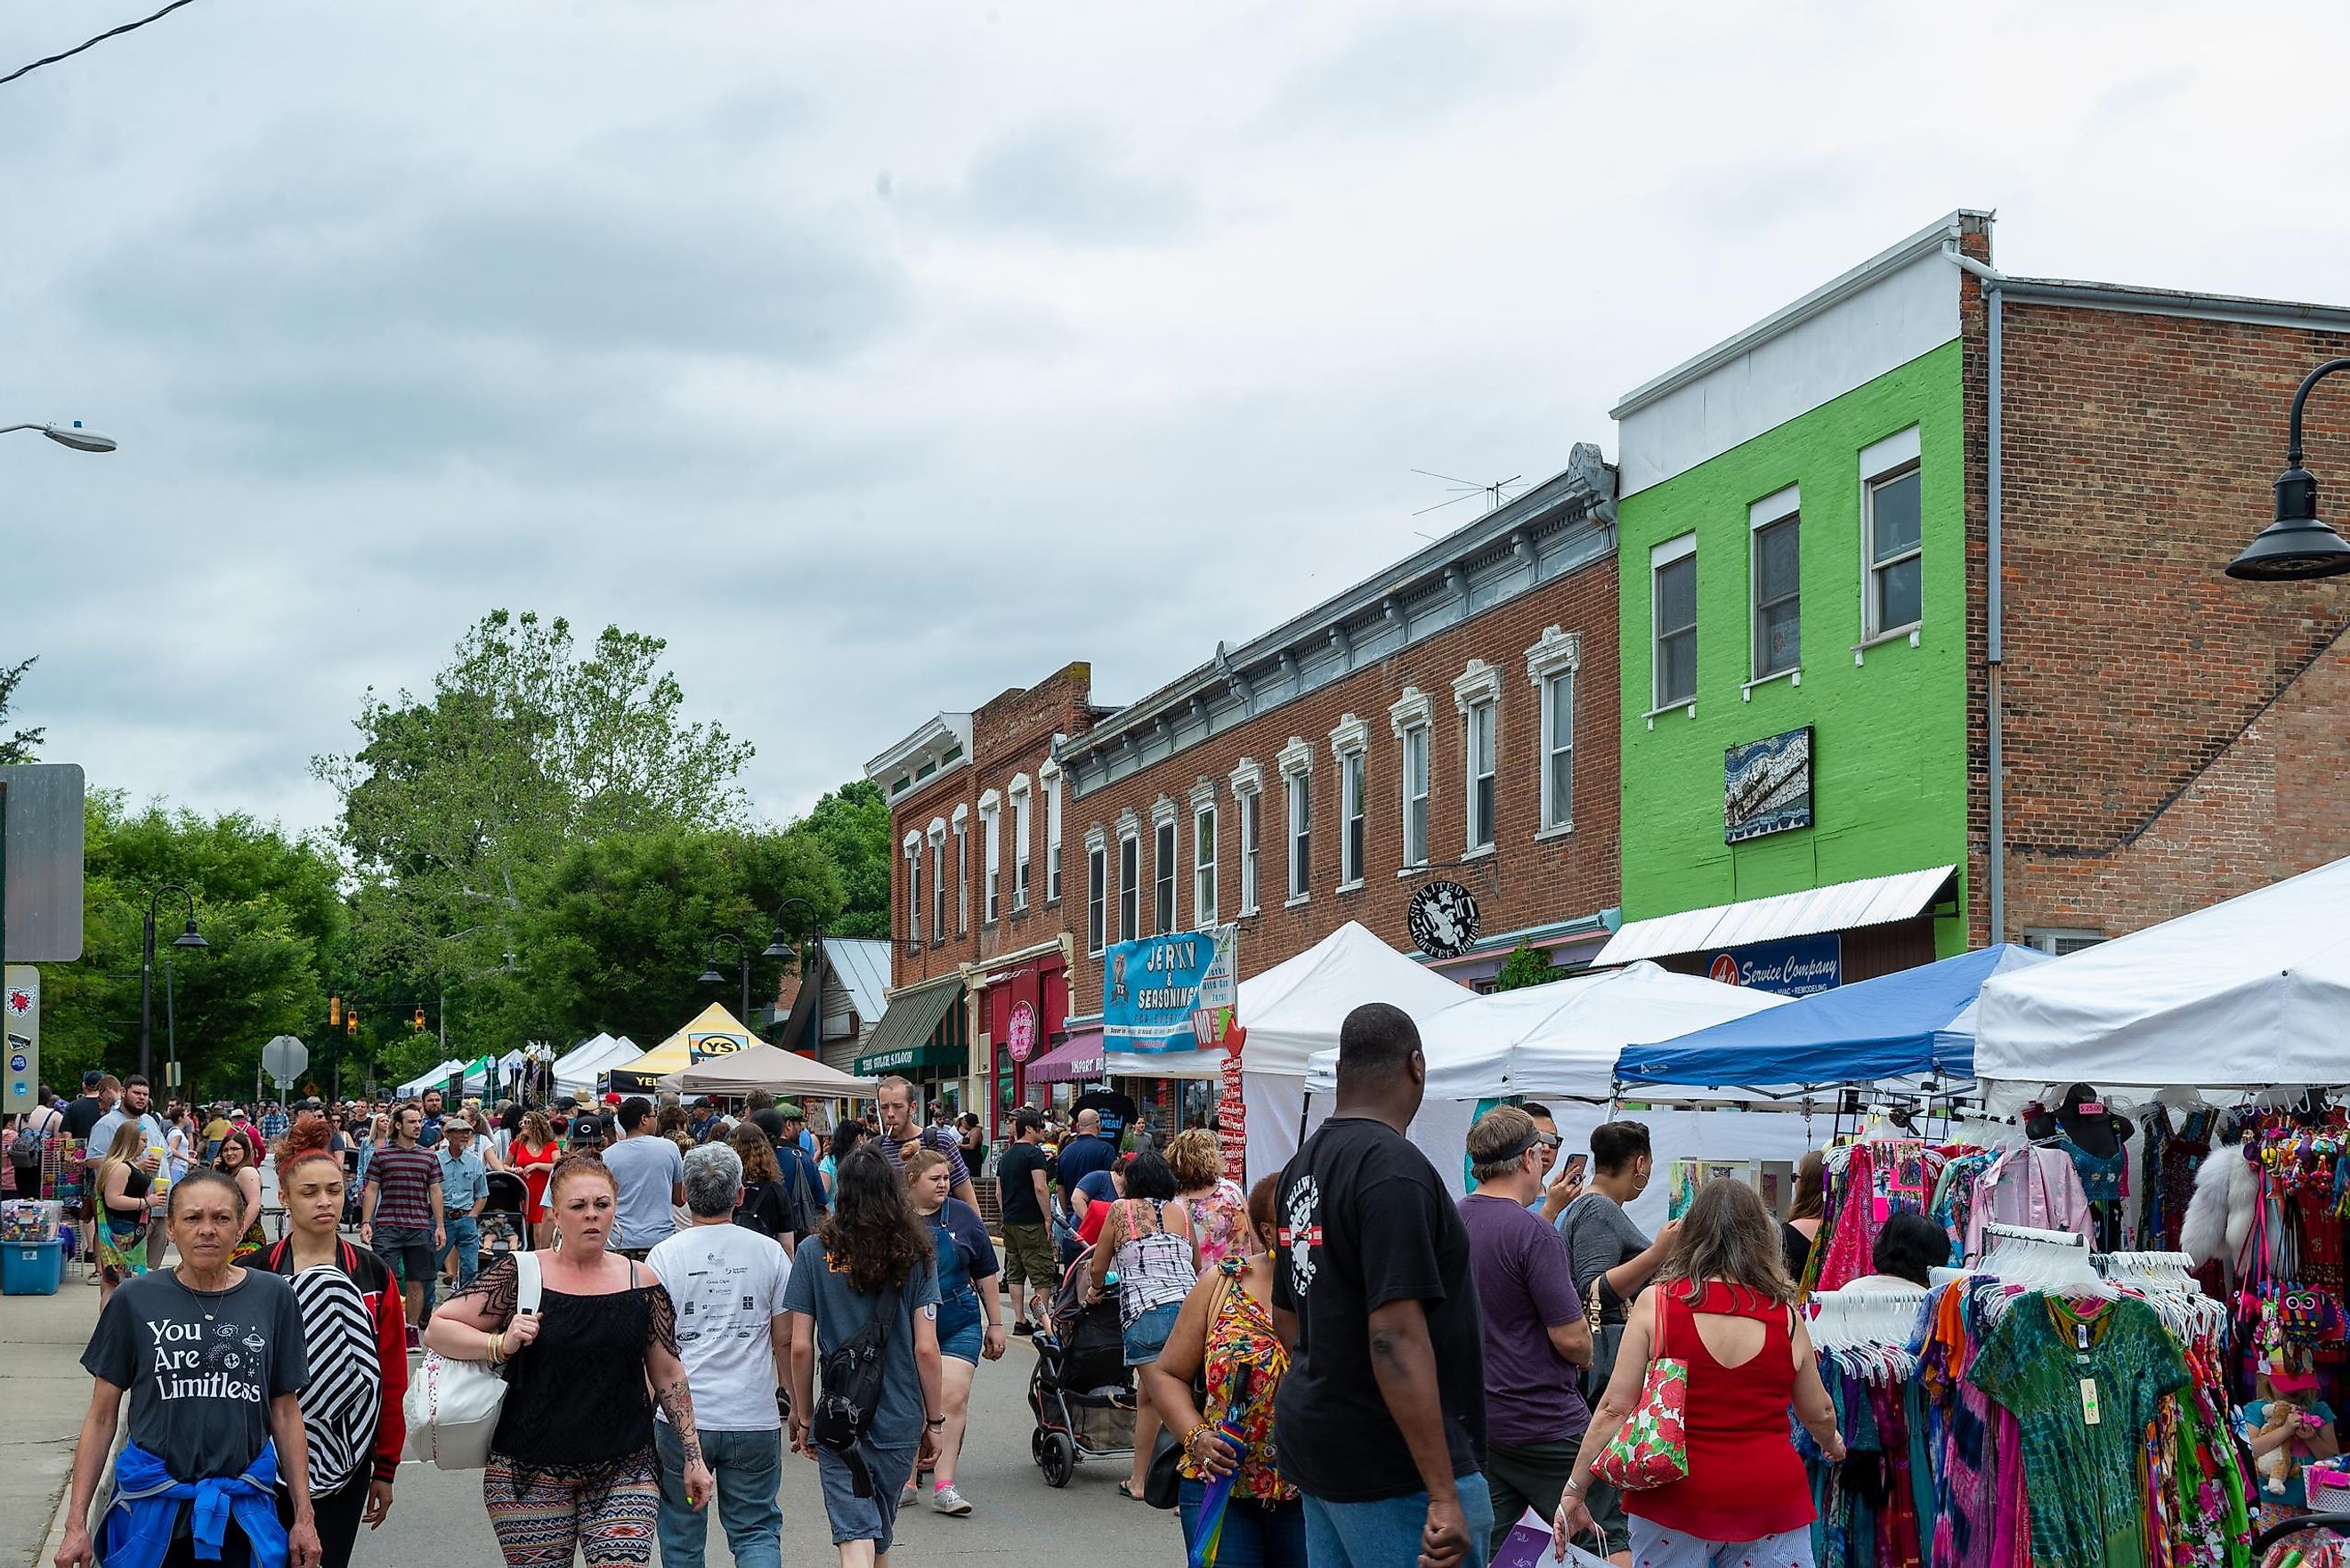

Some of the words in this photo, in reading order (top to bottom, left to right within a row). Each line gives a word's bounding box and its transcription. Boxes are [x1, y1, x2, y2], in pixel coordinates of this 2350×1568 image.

[1410, 882, 1463, 917] SPIRITED
[1413, 931, 1455, 958] COFFEE
[1457, 917, 1480, 955] HOUSE
[1147, 941, 1196, 972] JERKY
[1165, 973, 1173, 987] &
[1740, 961, 1782, 985] Service
[1783, 955, 1837, 983] Company
[1794, 983, 1828, 994] REMODELING
[1194, 1010, 1212, 1045] NO
[707, 1042, 734, 1053] YS
[890, 1051, 913, 1066] SALOON
[1071, 1059, 1094, 1073] IMPORT
[580, 1124, 591, 1133] C
[146, 1319, 202, 1345] You
[154, 1346, 200, 1372] Are
[156, 1372, 261, 1402] Limitless
